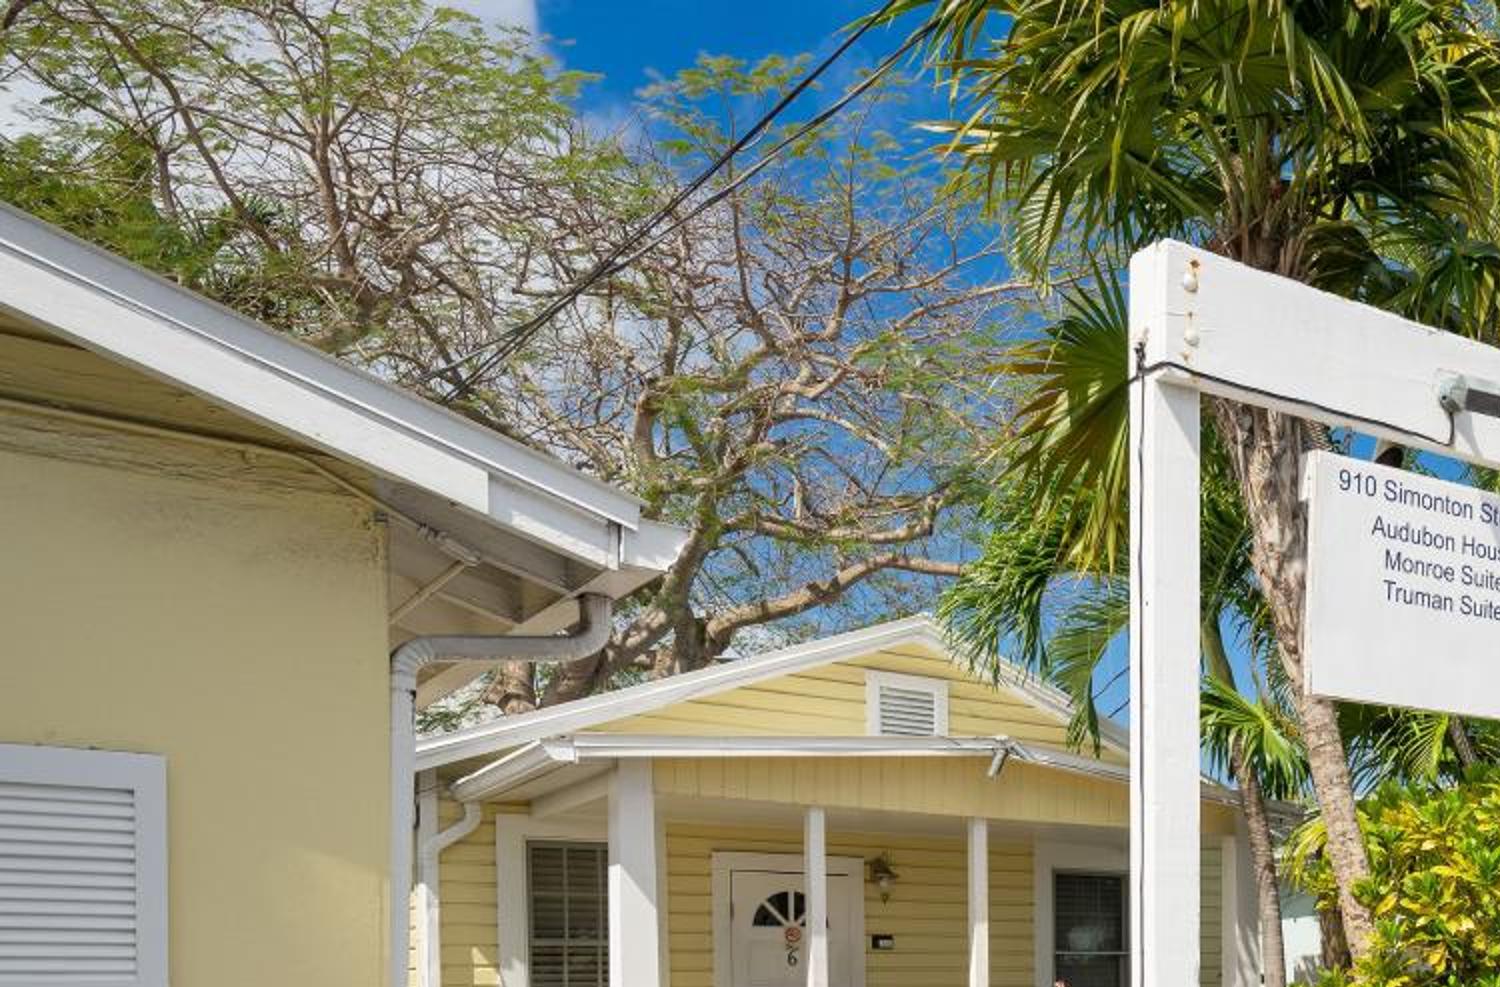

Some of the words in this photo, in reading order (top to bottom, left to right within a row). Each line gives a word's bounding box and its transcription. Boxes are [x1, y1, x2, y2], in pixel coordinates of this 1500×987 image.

[1339, 469, 1377, 497] 910
[1383, 480, 1473, 520] Simonton
[1371, 515, 1455, 549] Audubon
[1385, 550, 1455, 583] Monroe
[1383, 580, 1453, 612] Truman
